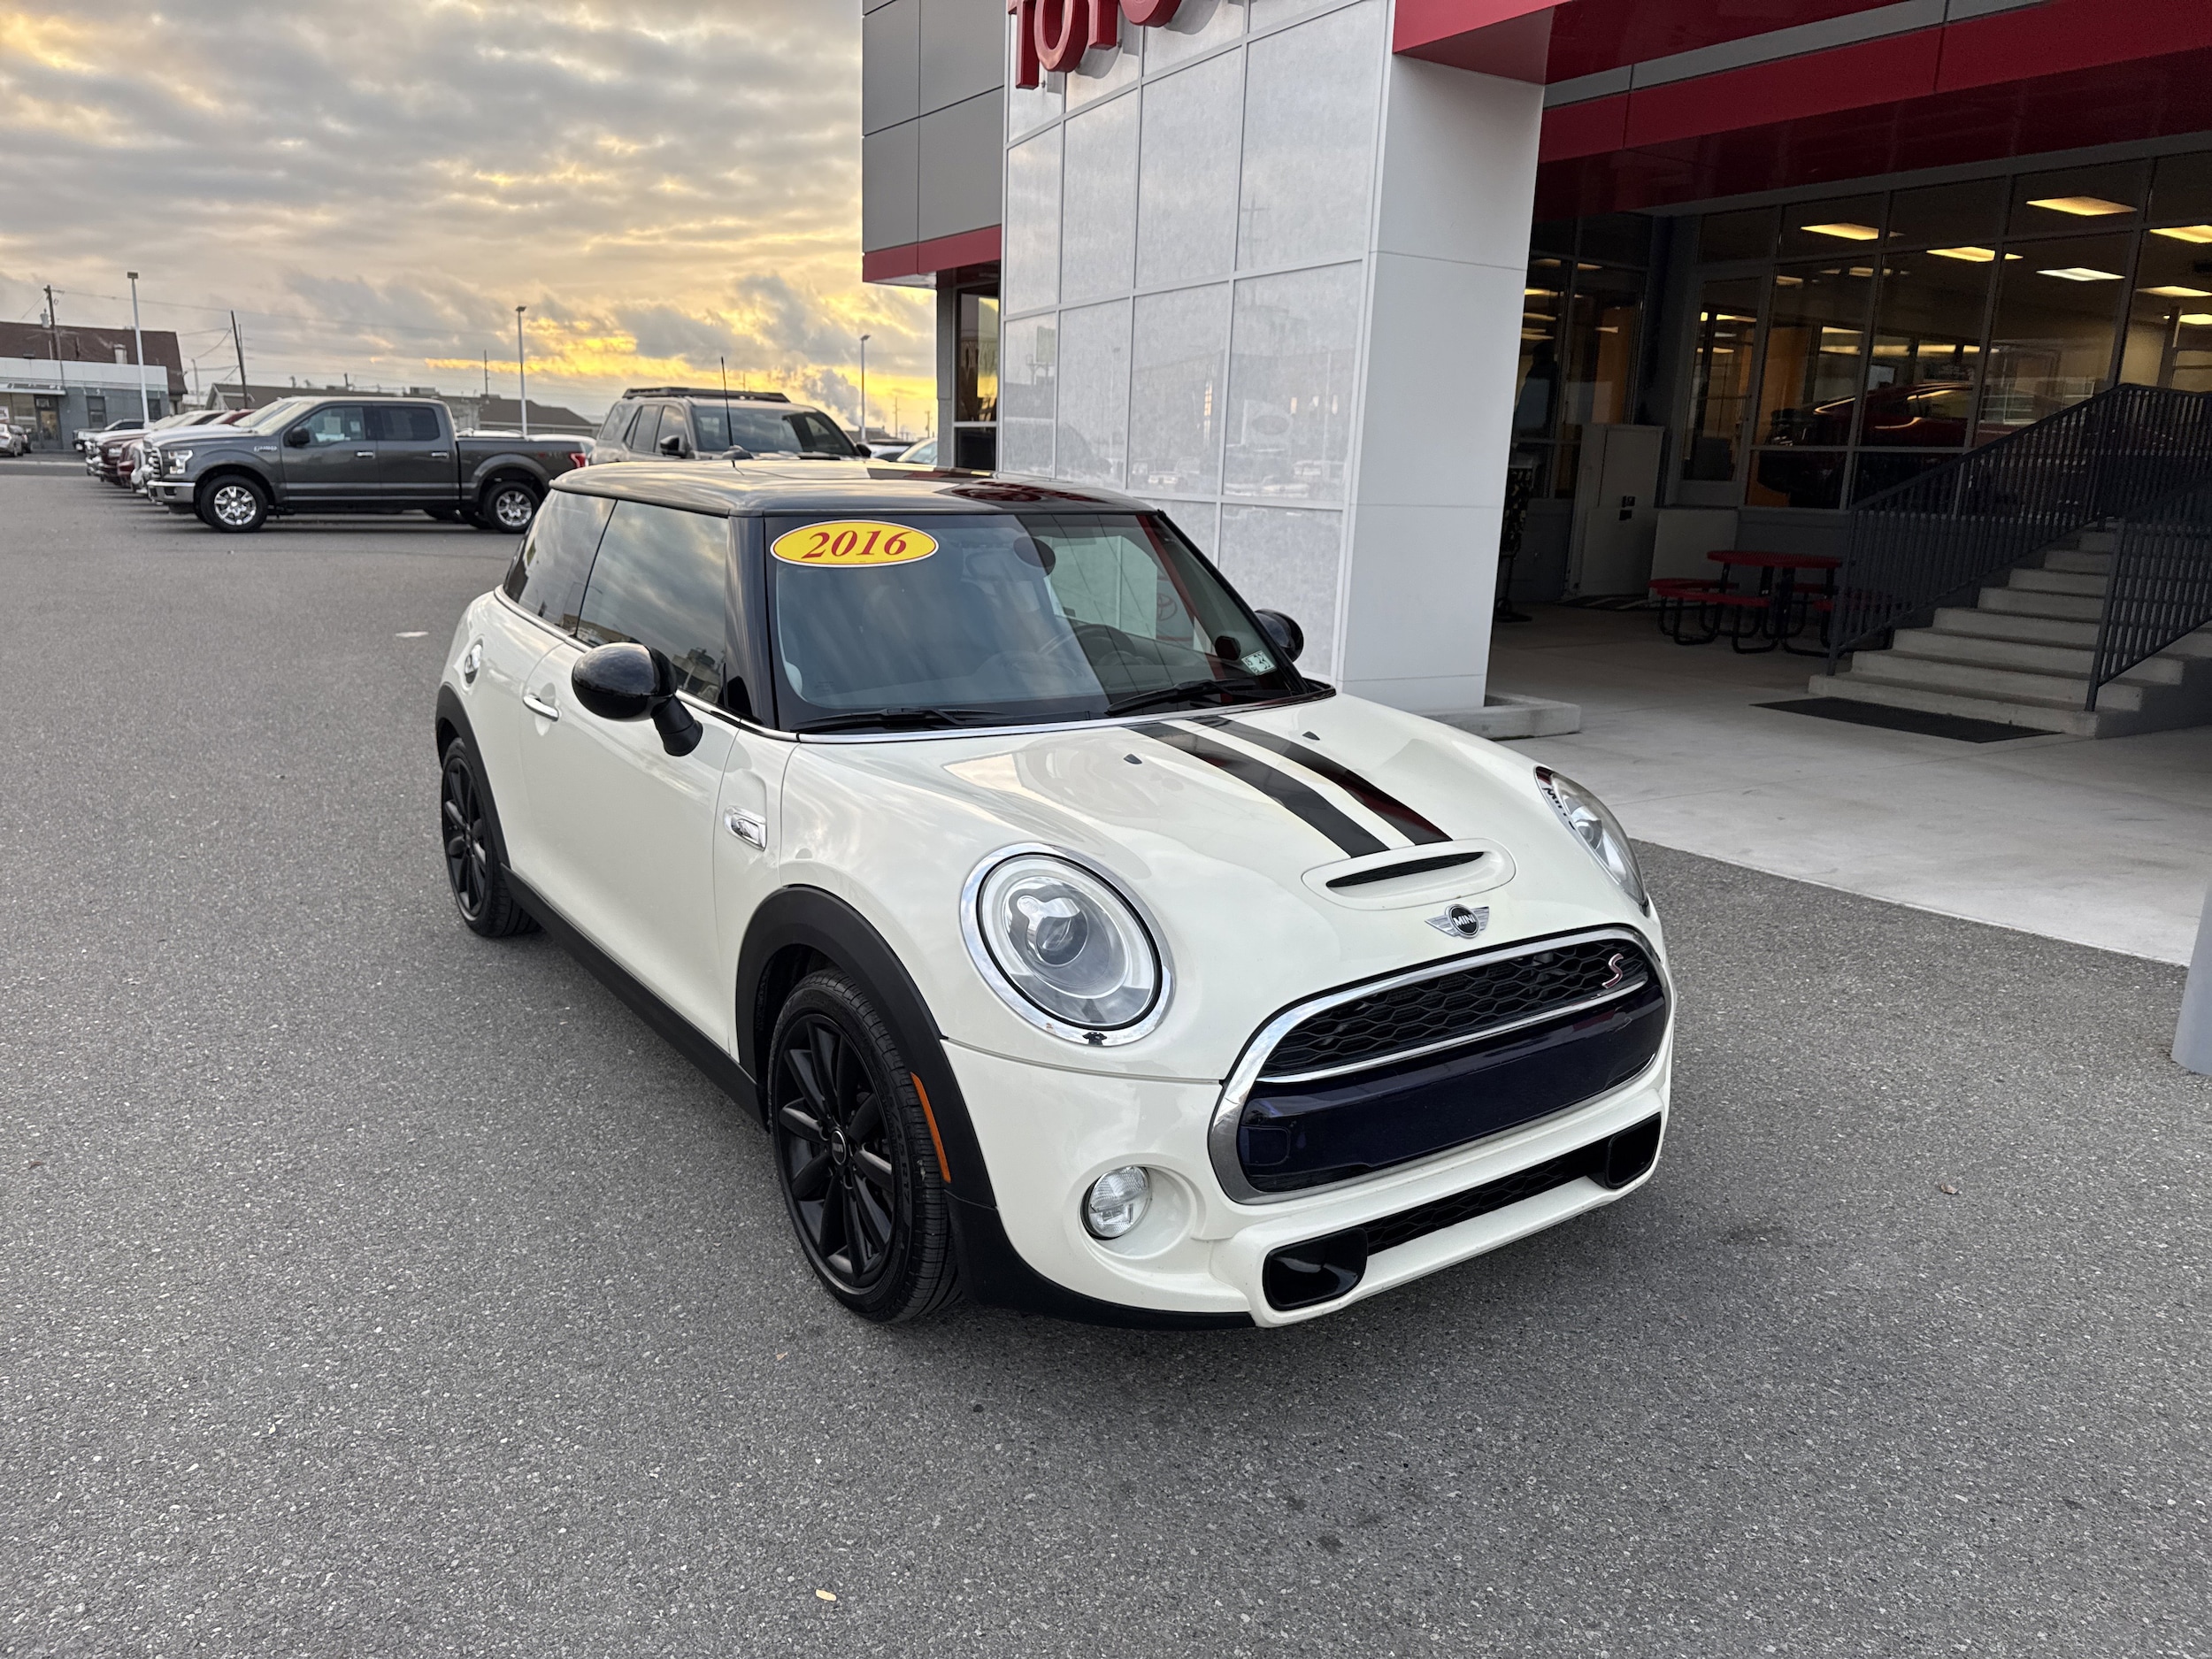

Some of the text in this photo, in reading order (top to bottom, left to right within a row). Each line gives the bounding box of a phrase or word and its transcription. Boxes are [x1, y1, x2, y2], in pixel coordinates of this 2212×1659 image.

[801, 529, 912, 559] 2016
[1453, 914, 1477, 926] MINI
[1601, 953, 1624, 989] S
